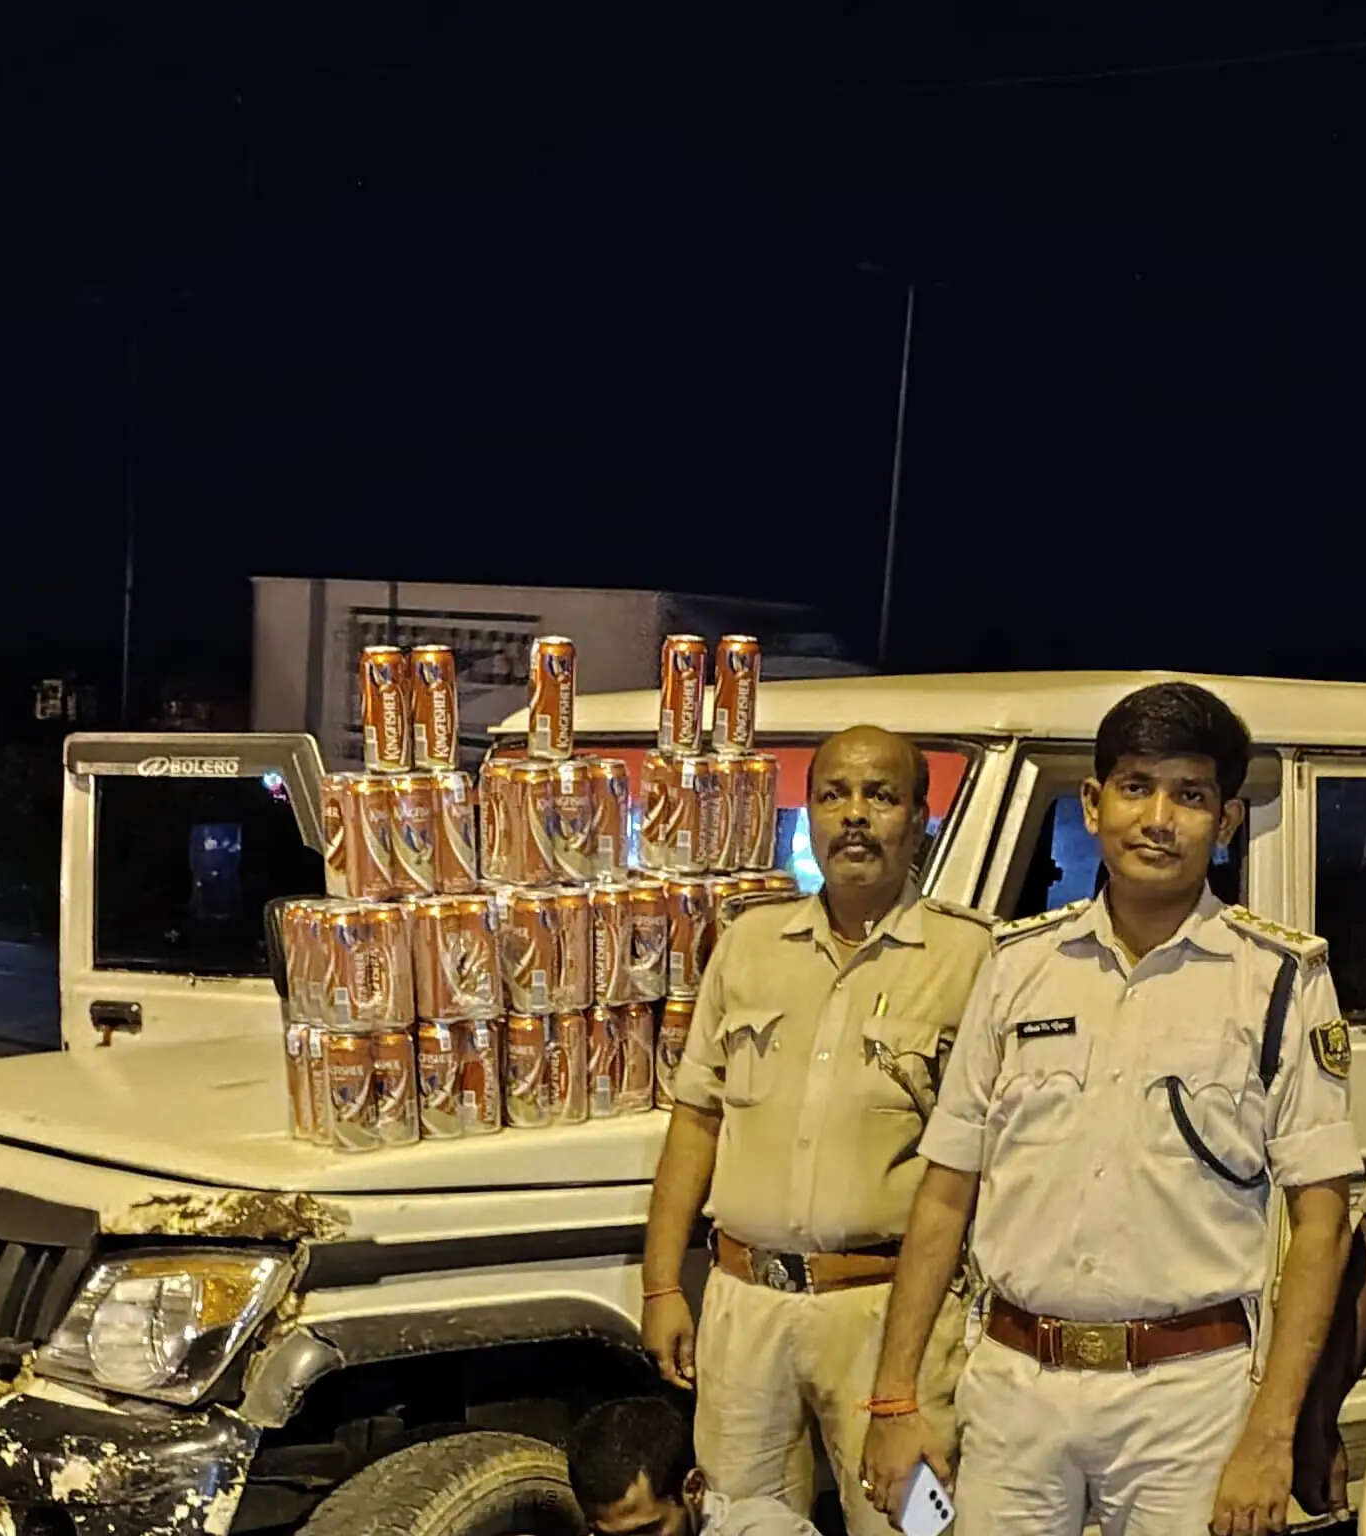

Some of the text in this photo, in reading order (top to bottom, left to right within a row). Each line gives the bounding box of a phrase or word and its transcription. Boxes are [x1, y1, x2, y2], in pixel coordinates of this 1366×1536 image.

[383, 690, 400, 760] KINGFISHER
[433, 689, 450, 759] KINGFISHER
[556, 681, 572, 748] KINGFISHER
[679, 678, 698, 743] KINGFISHER
[733, 678, 752, 743] KINGFISHER
[169, 758, 239, 775] BOLERO
